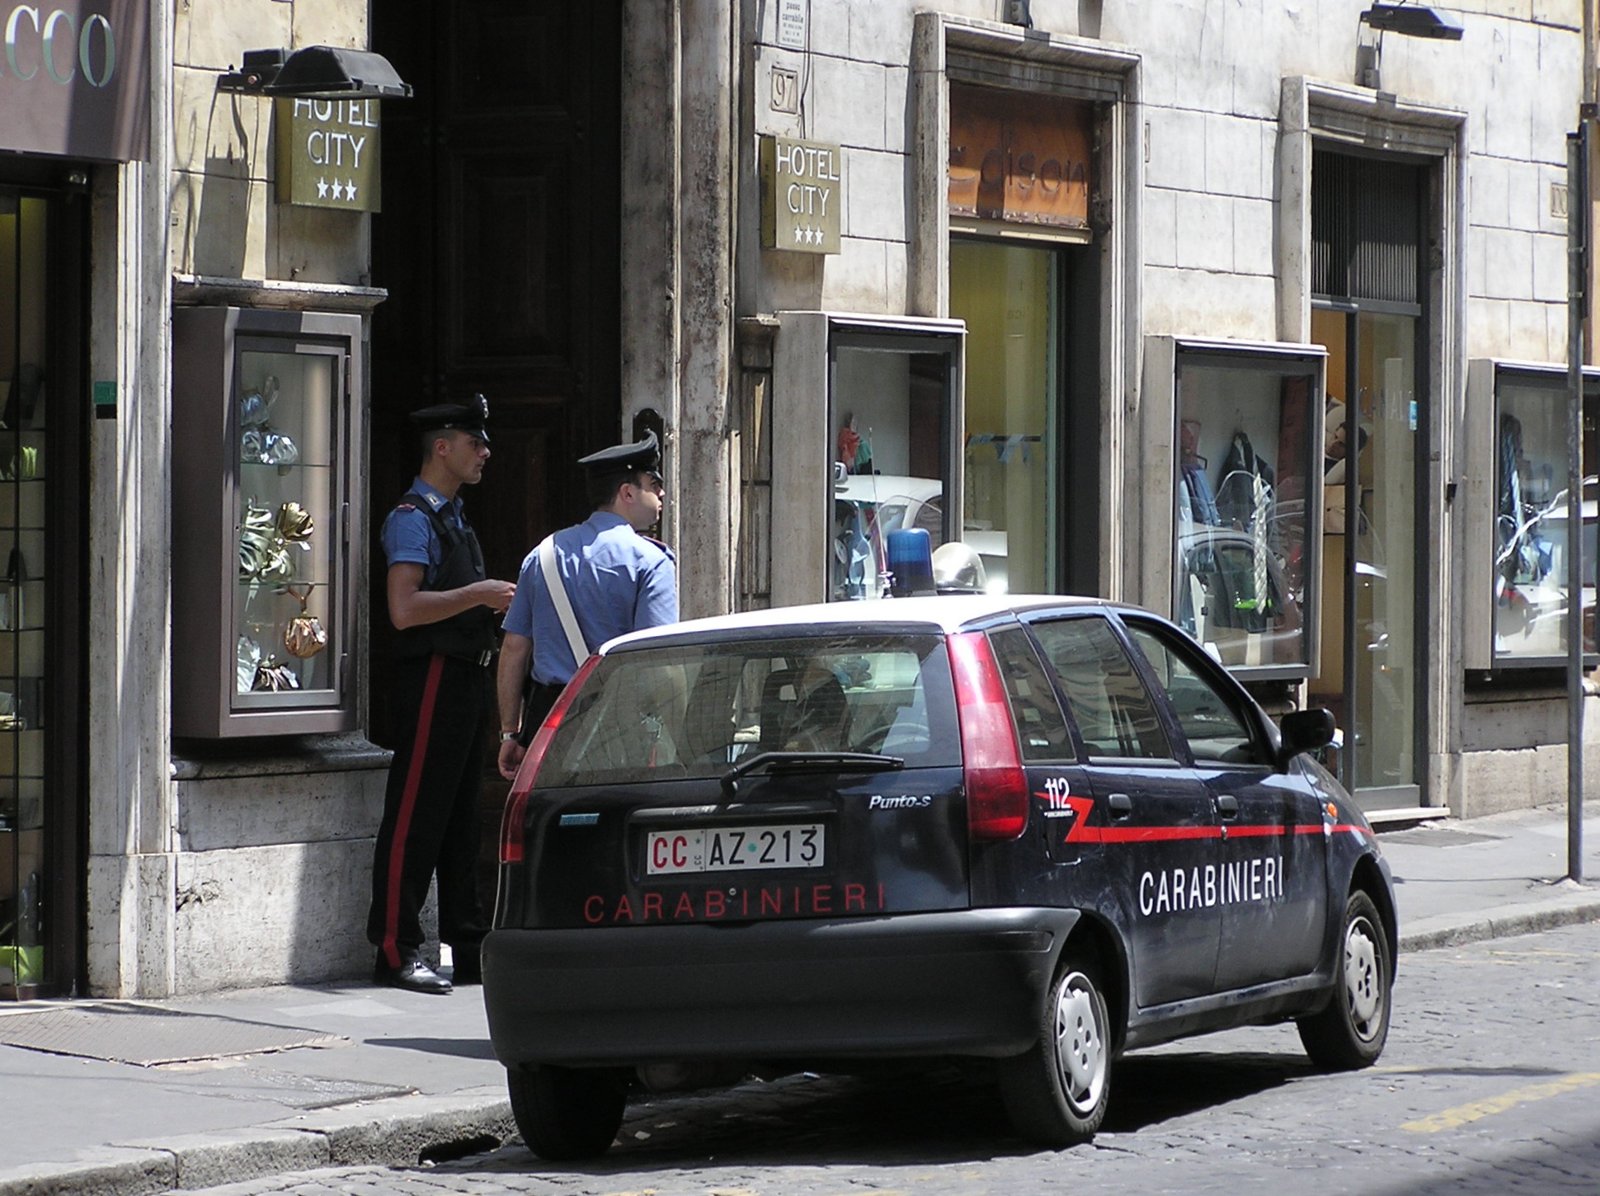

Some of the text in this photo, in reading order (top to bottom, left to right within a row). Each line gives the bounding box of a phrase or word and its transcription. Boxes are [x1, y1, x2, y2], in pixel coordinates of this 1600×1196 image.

[0, 5, 115, 88] CCO
[773, 74, 795, 108] 97
[307, 131, 366, 169] CITY
[776, 145, 840, 181] HOTEL
[787, 184, 830, 217] CITY
[1044, 777, 1072, 809] 112
[653, 829, 818, 869] CC AZ 213
[583, 883, 885, 923] CARABINIERI
[1139, 855, 1284, 916] CARABINIERI
